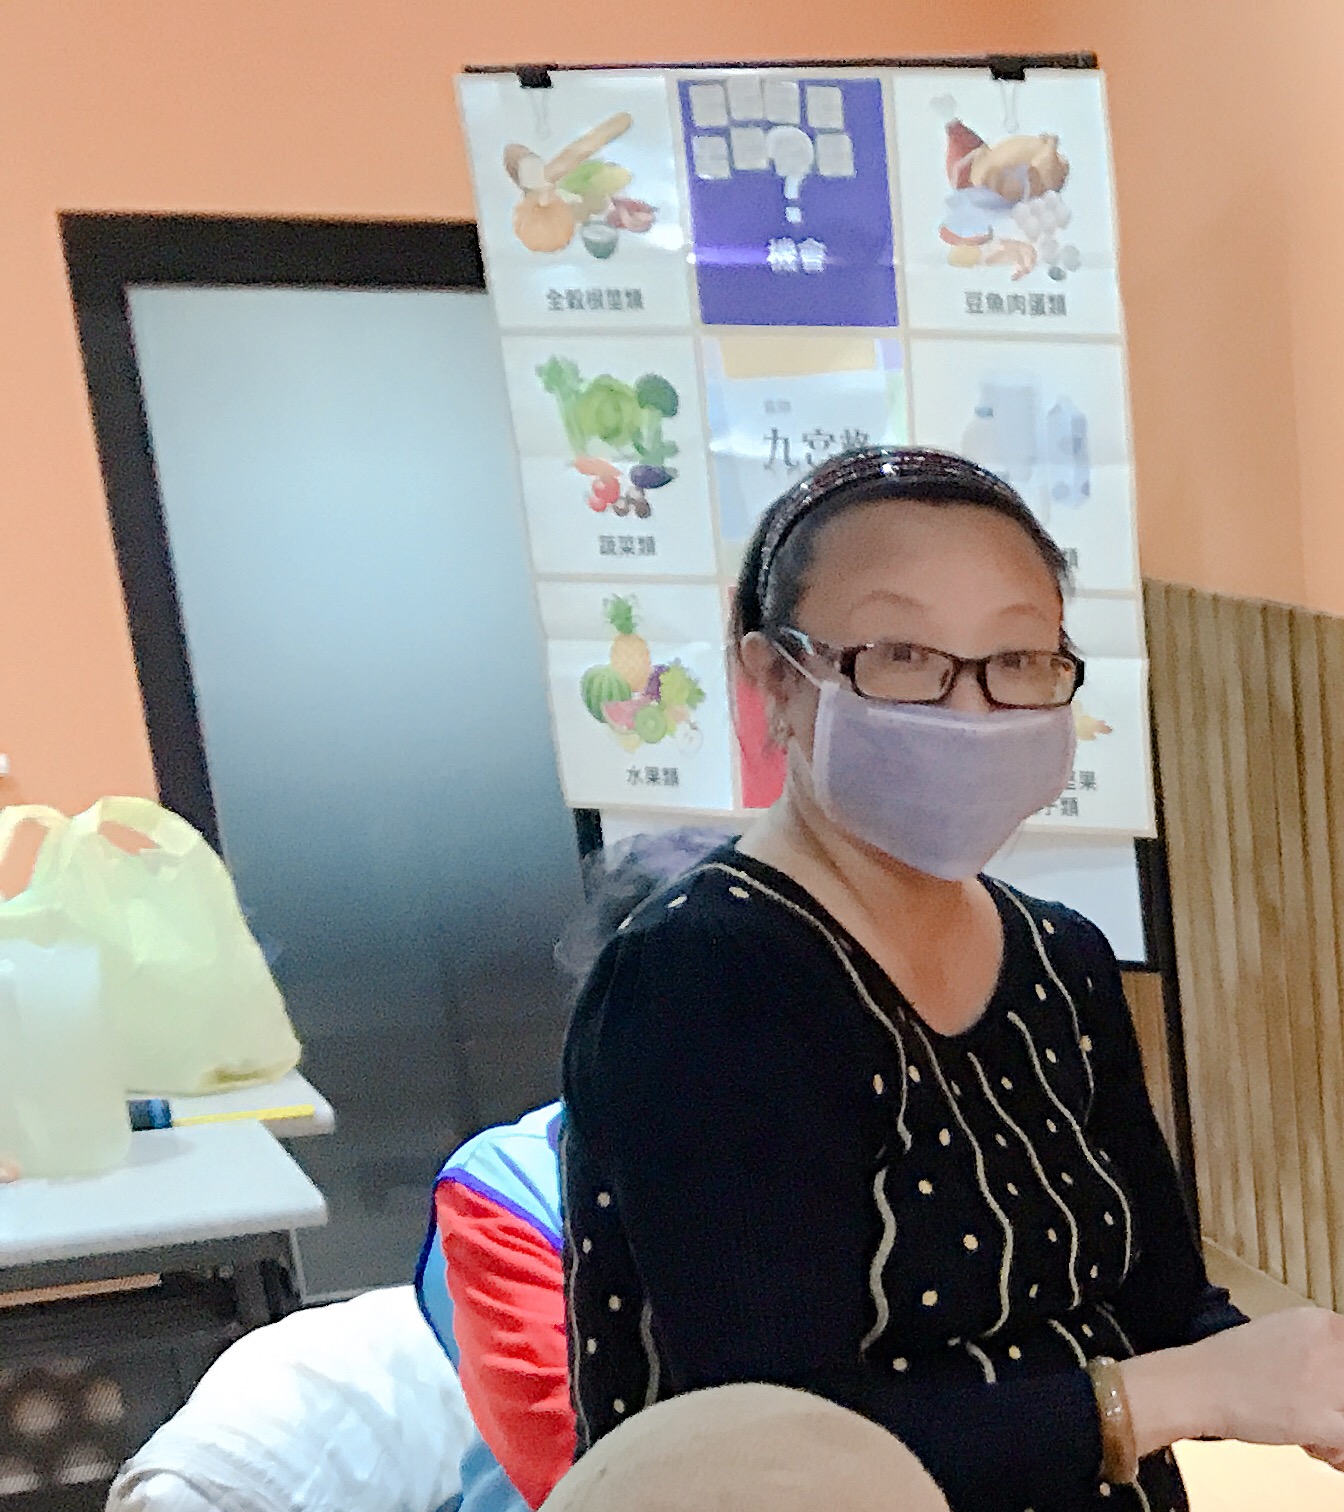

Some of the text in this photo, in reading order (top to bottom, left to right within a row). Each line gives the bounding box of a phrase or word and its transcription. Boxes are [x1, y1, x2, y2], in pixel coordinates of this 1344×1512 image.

[964, 291, 1067, 316] 豆魚肉蛋類
[599, 535, 656, 555] 蔬菜類
[626, 765, 679, 786] 水果類
